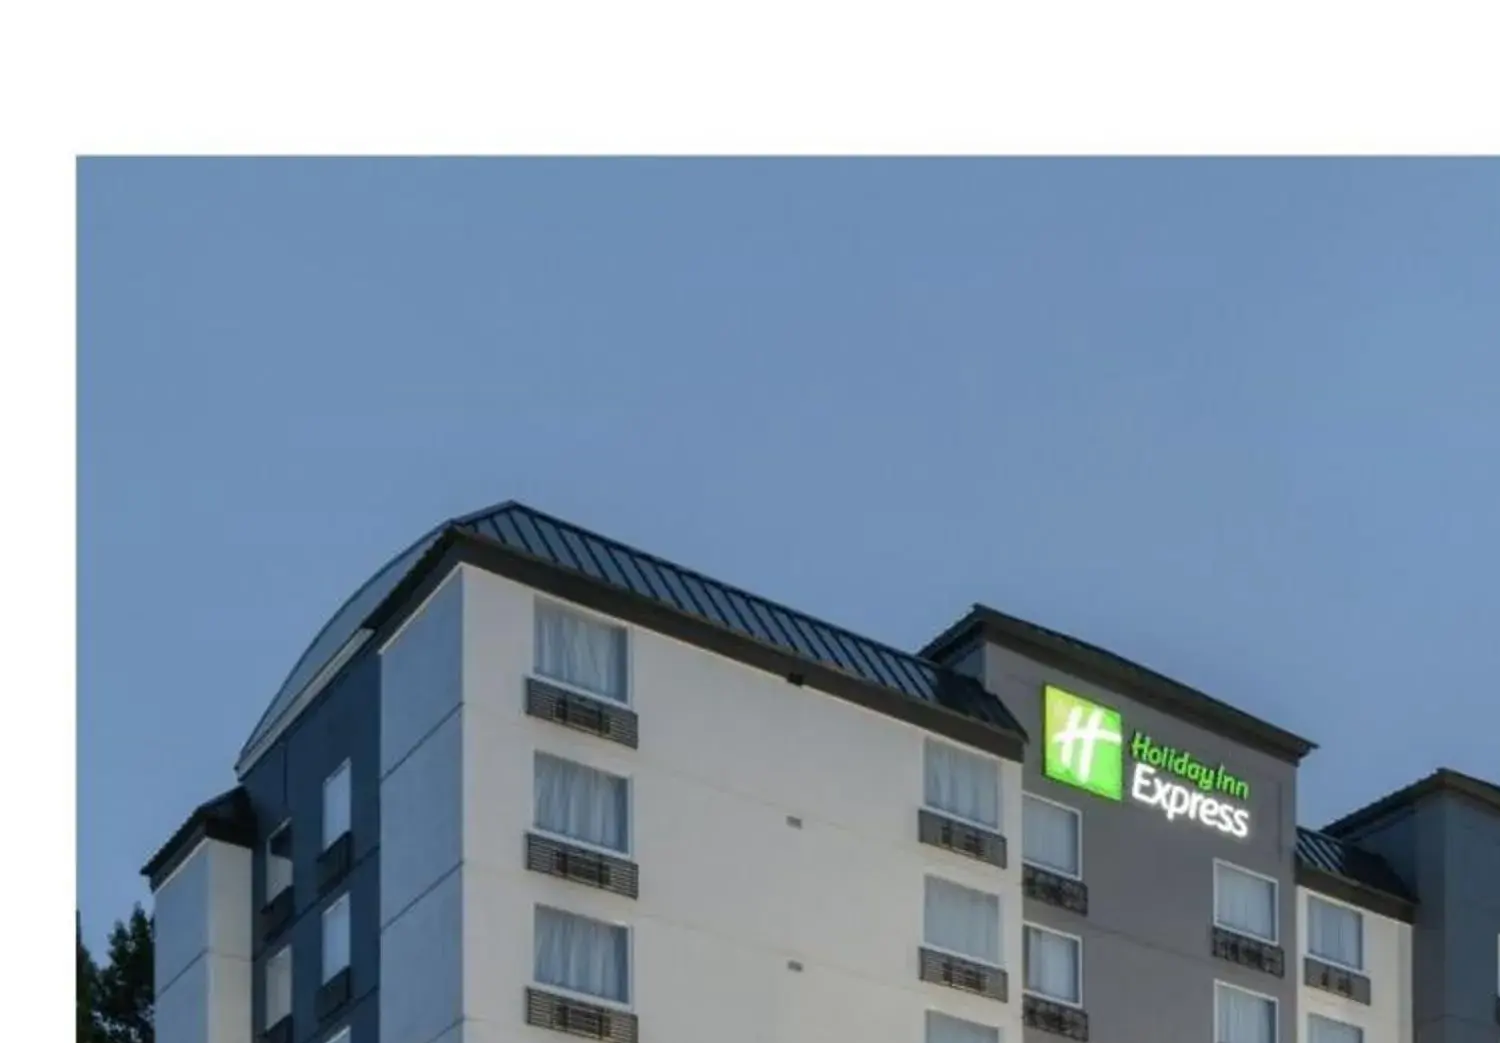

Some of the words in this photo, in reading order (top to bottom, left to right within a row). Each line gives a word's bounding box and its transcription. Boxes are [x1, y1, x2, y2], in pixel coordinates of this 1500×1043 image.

[1131, 731, 1215, 791] Holiday
[1216, 763, 1249, 800] Inn
[1131, 761, 1250, 838] Express
